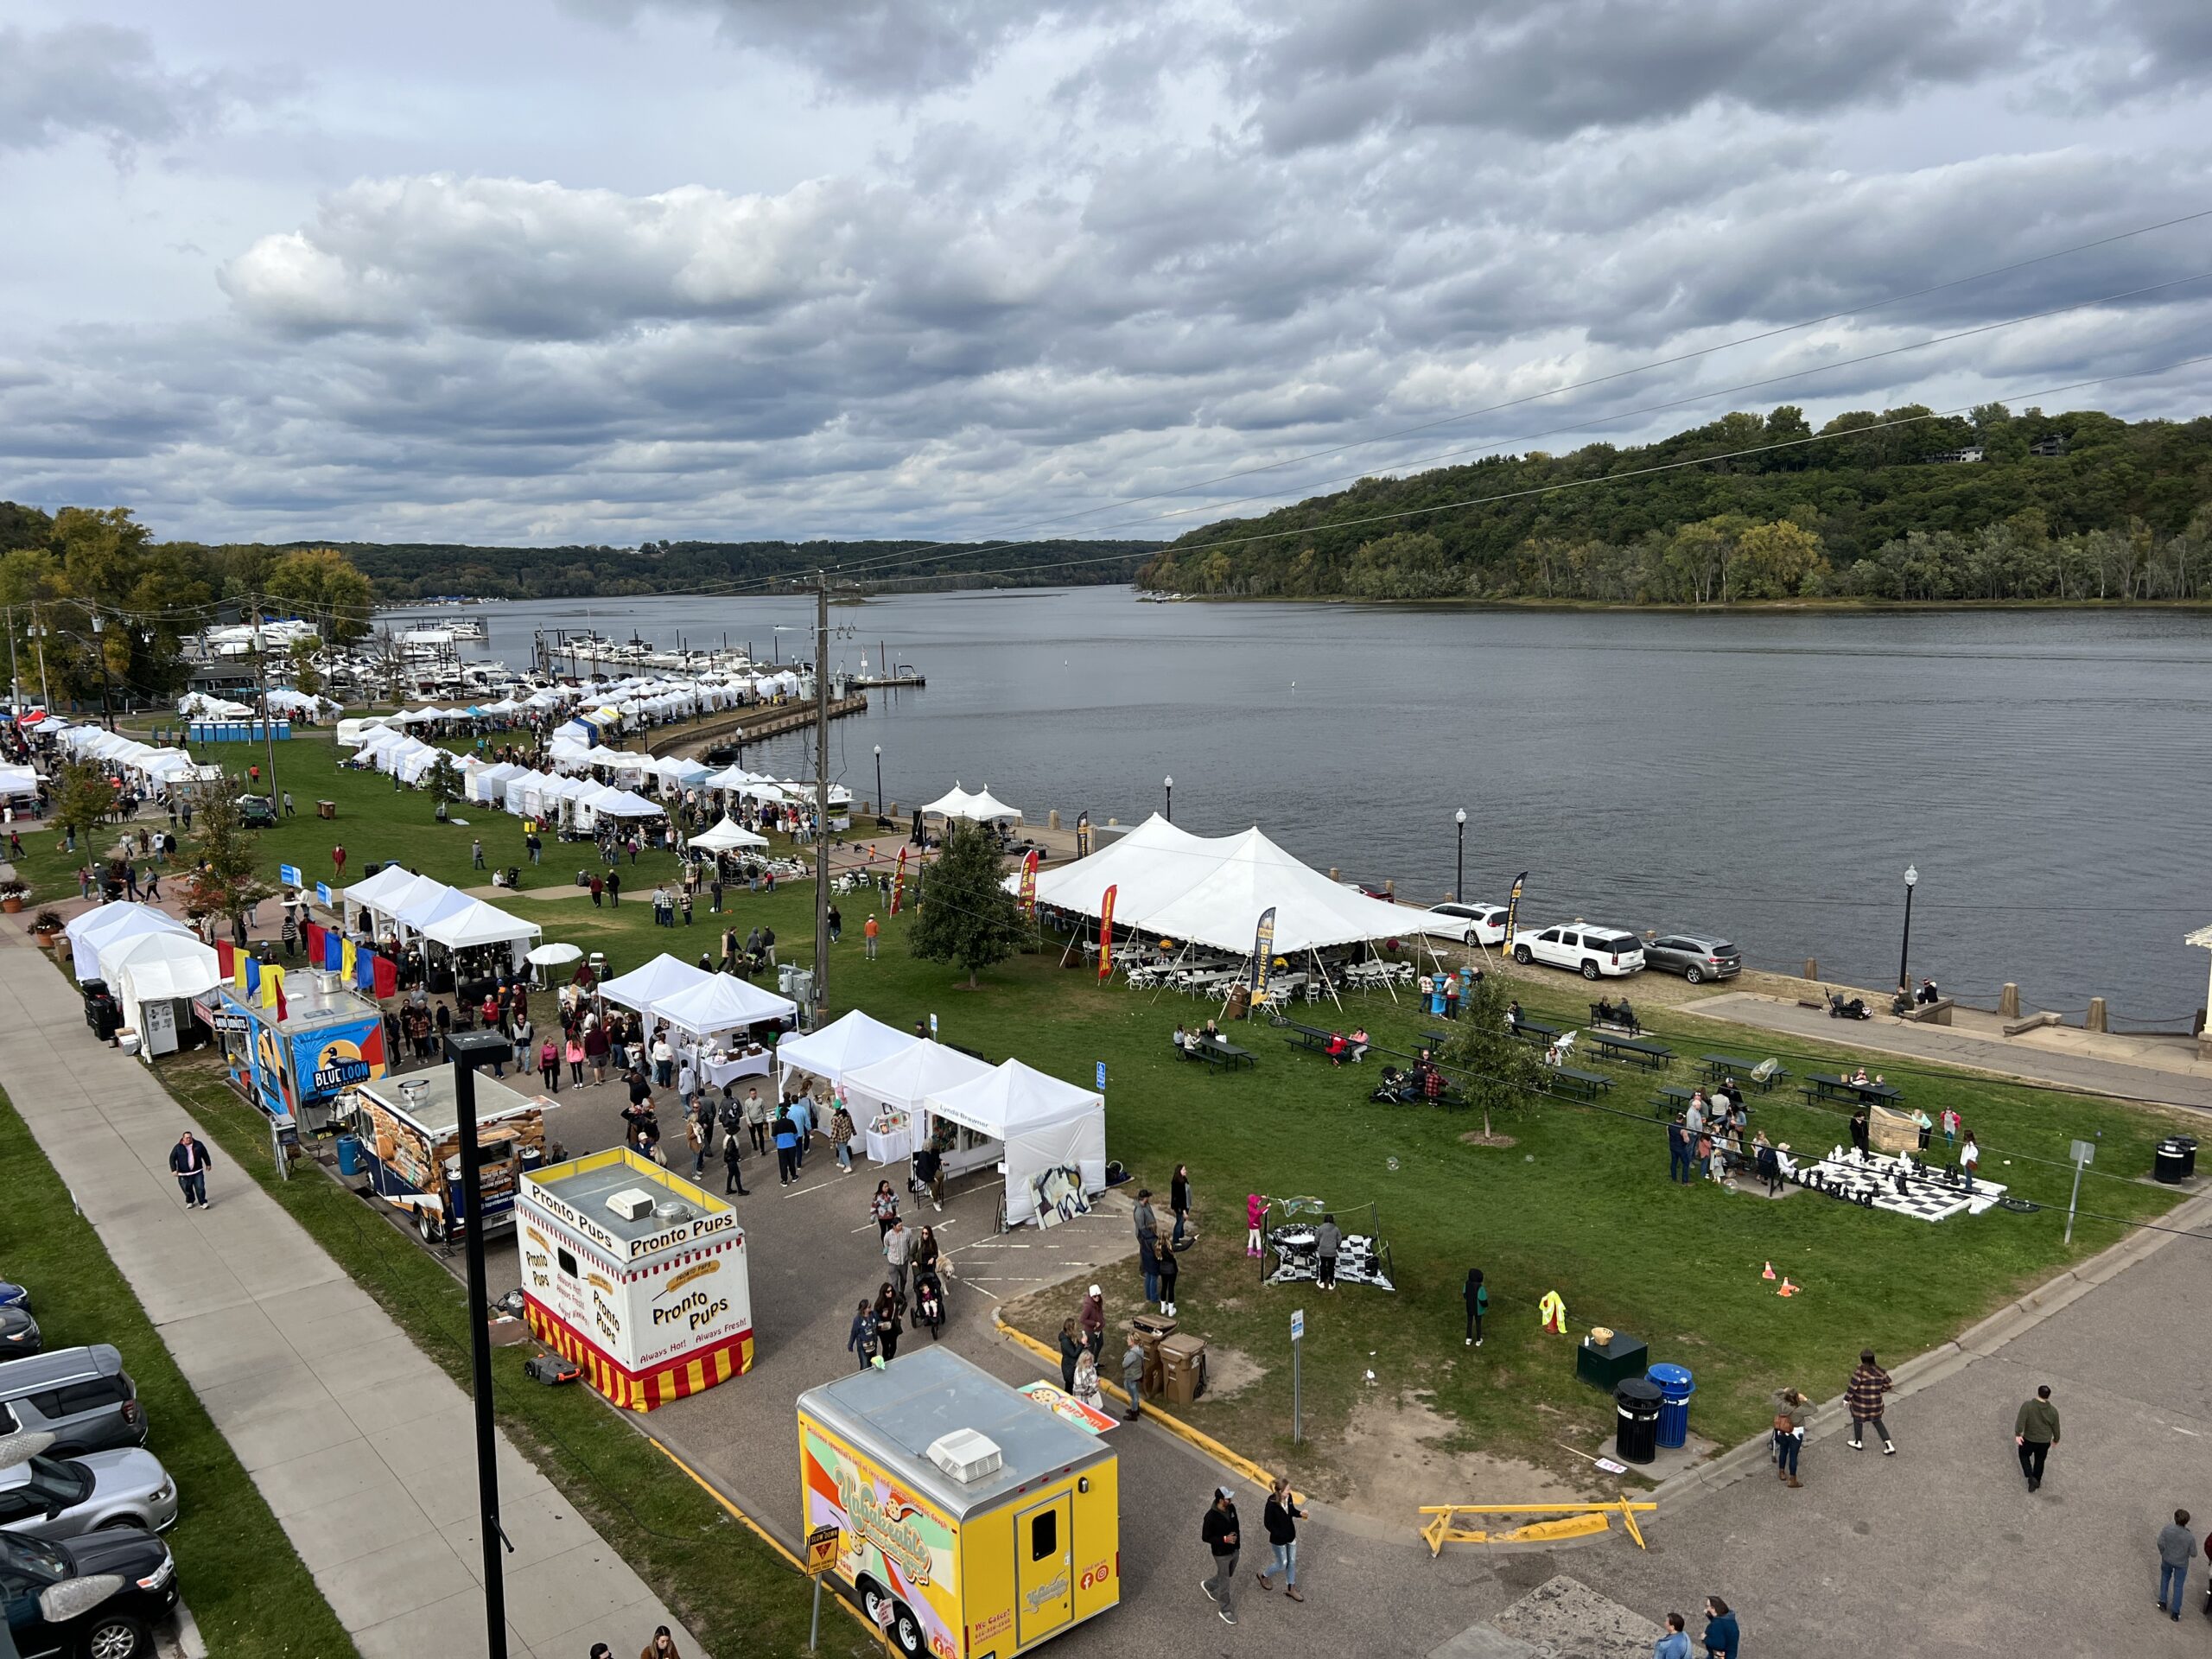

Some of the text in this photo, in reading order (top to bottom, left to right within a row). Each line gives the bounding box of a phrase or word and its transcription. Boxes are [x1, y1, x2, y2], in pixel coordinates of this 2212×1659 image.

[1021, 862, 1030, 888] BEER
[1258, 944, 1269, 987] BEER
[315, 1063, 368, 1087] BLUE LOON
[321, 1077, 365, 1090] CONCESSIONS
[940, 1103, 959, 1116] Lynda
[532, 1185, 575, 1223] Pronto
[579, 1213, 613, 1249] Pups
[631, 1214, 733, 1256] Pronto Pups
[525, 1251, 548, 1268] Pronto
[532, 1270, 550, 1287] Pups
[594, 1290, 620, 1332] Pronto
[652, 1292, 708, 1325] Pronto
[690, 1299, 728, 1331] Pups
[596, 1311, 616, 1344] Pups
[696, 1318, 747, 1344] Always Fresh!
[639, 1339, 687, 1363] Always Hot!
[807, 1425, 828, 1444] Delicious
[835, 1467, 929, 1571] Unbakeable
[823, 1529, 837, 1539] DOWN
[975, 1608, 1011, 1631] We Cater!
